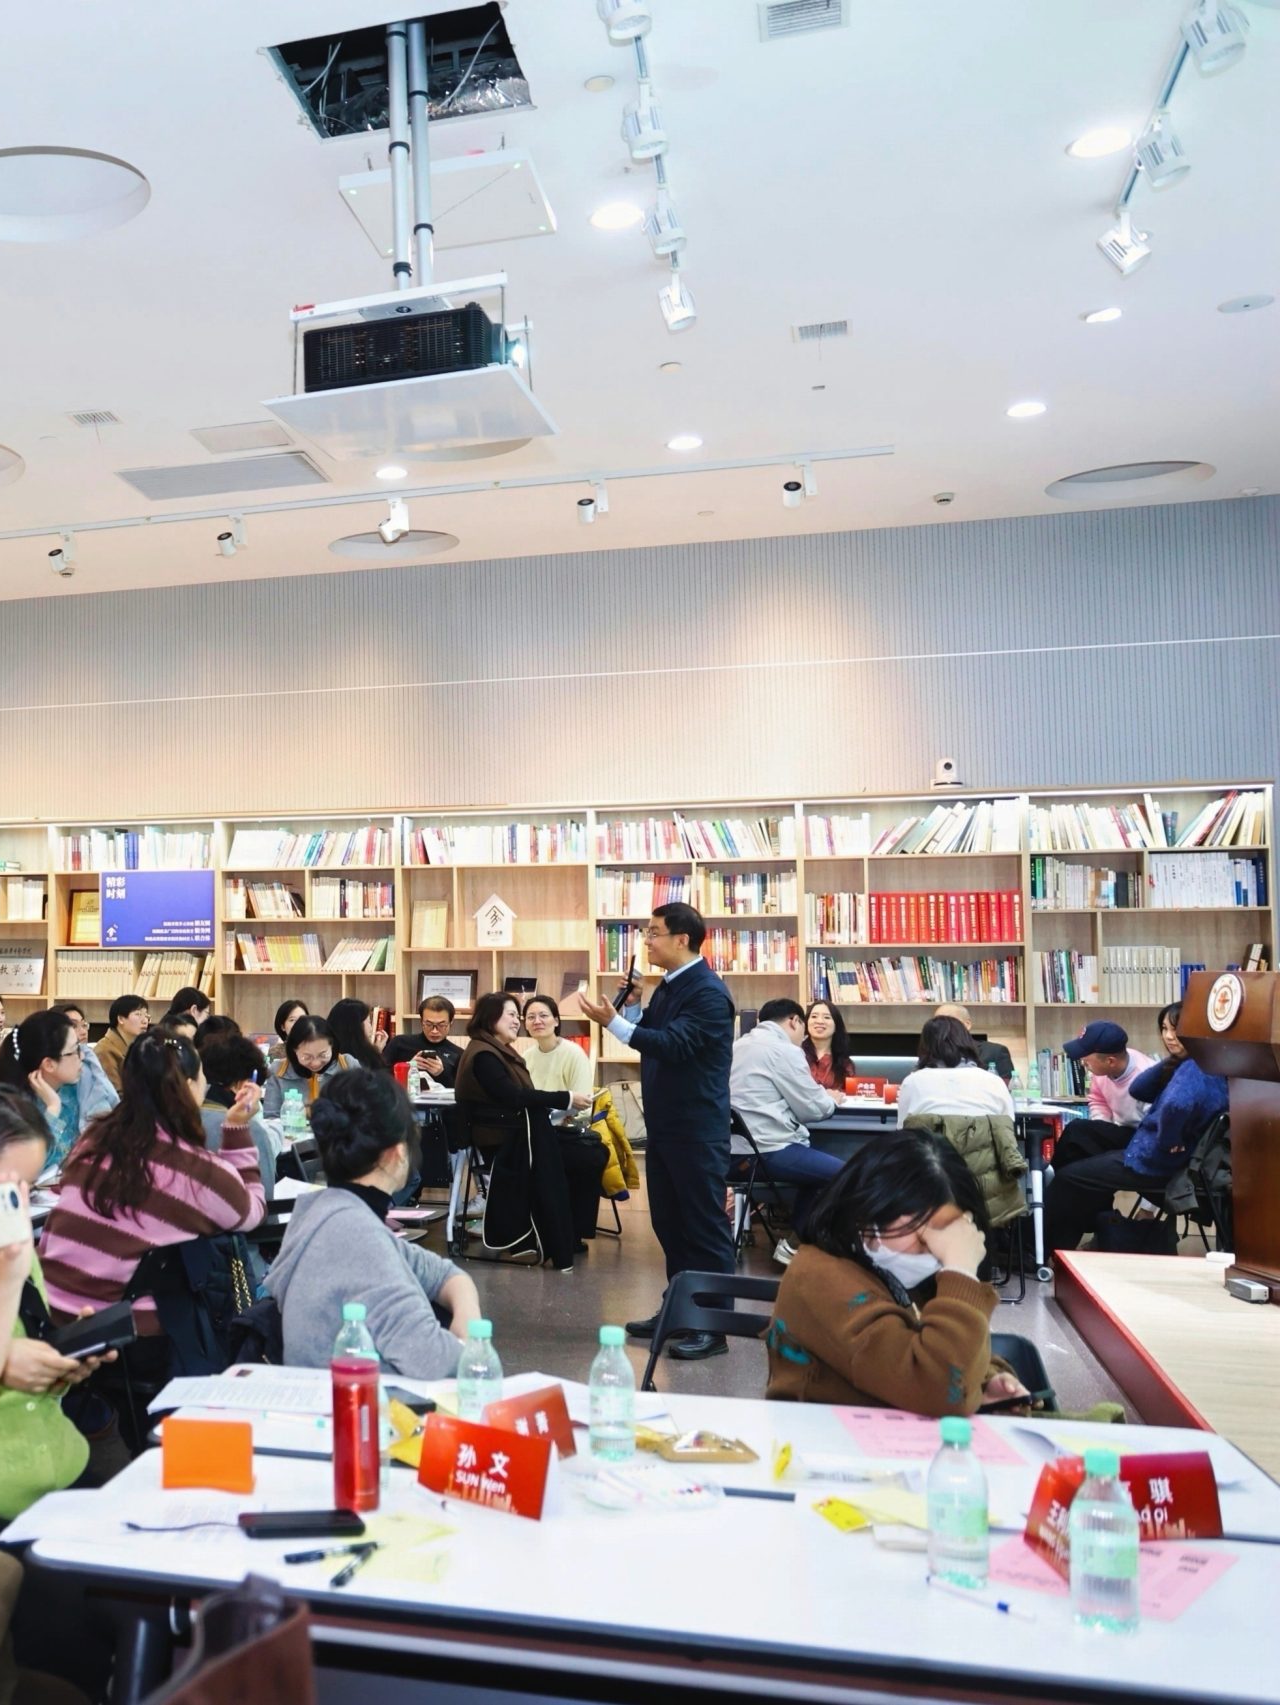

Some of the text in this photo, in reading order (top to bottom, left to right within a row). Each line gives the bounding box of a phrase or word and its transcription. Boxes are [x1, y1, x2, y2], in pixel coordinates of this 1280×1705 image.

[105, 876, 126, 888] 精彩
[105, 888, 126, 899] 时刻
[455, 1469, 506, 1494] SUN Wen
